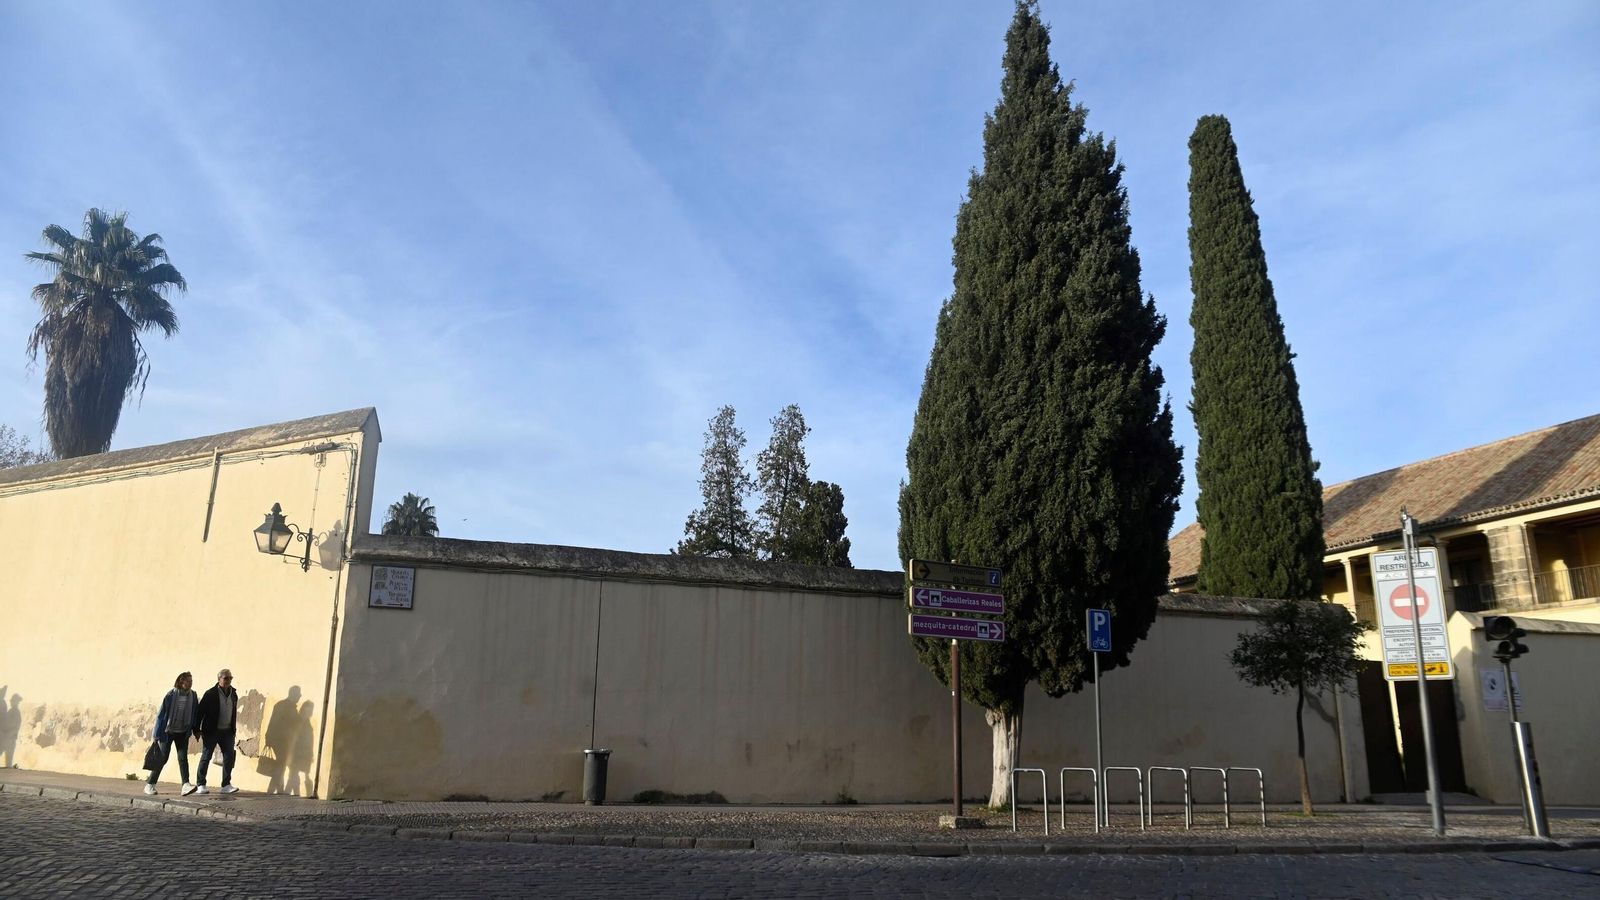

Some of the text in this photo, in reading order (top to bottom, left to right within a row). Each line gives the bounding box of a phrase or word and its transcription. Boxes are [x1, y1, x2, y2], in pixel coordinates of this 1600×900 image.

[941, 596, 1002, 608] Caballerizas Reales
[913, 621, 977, 632] mezquita-catedral
[1094, 612, 1106, 631] P
